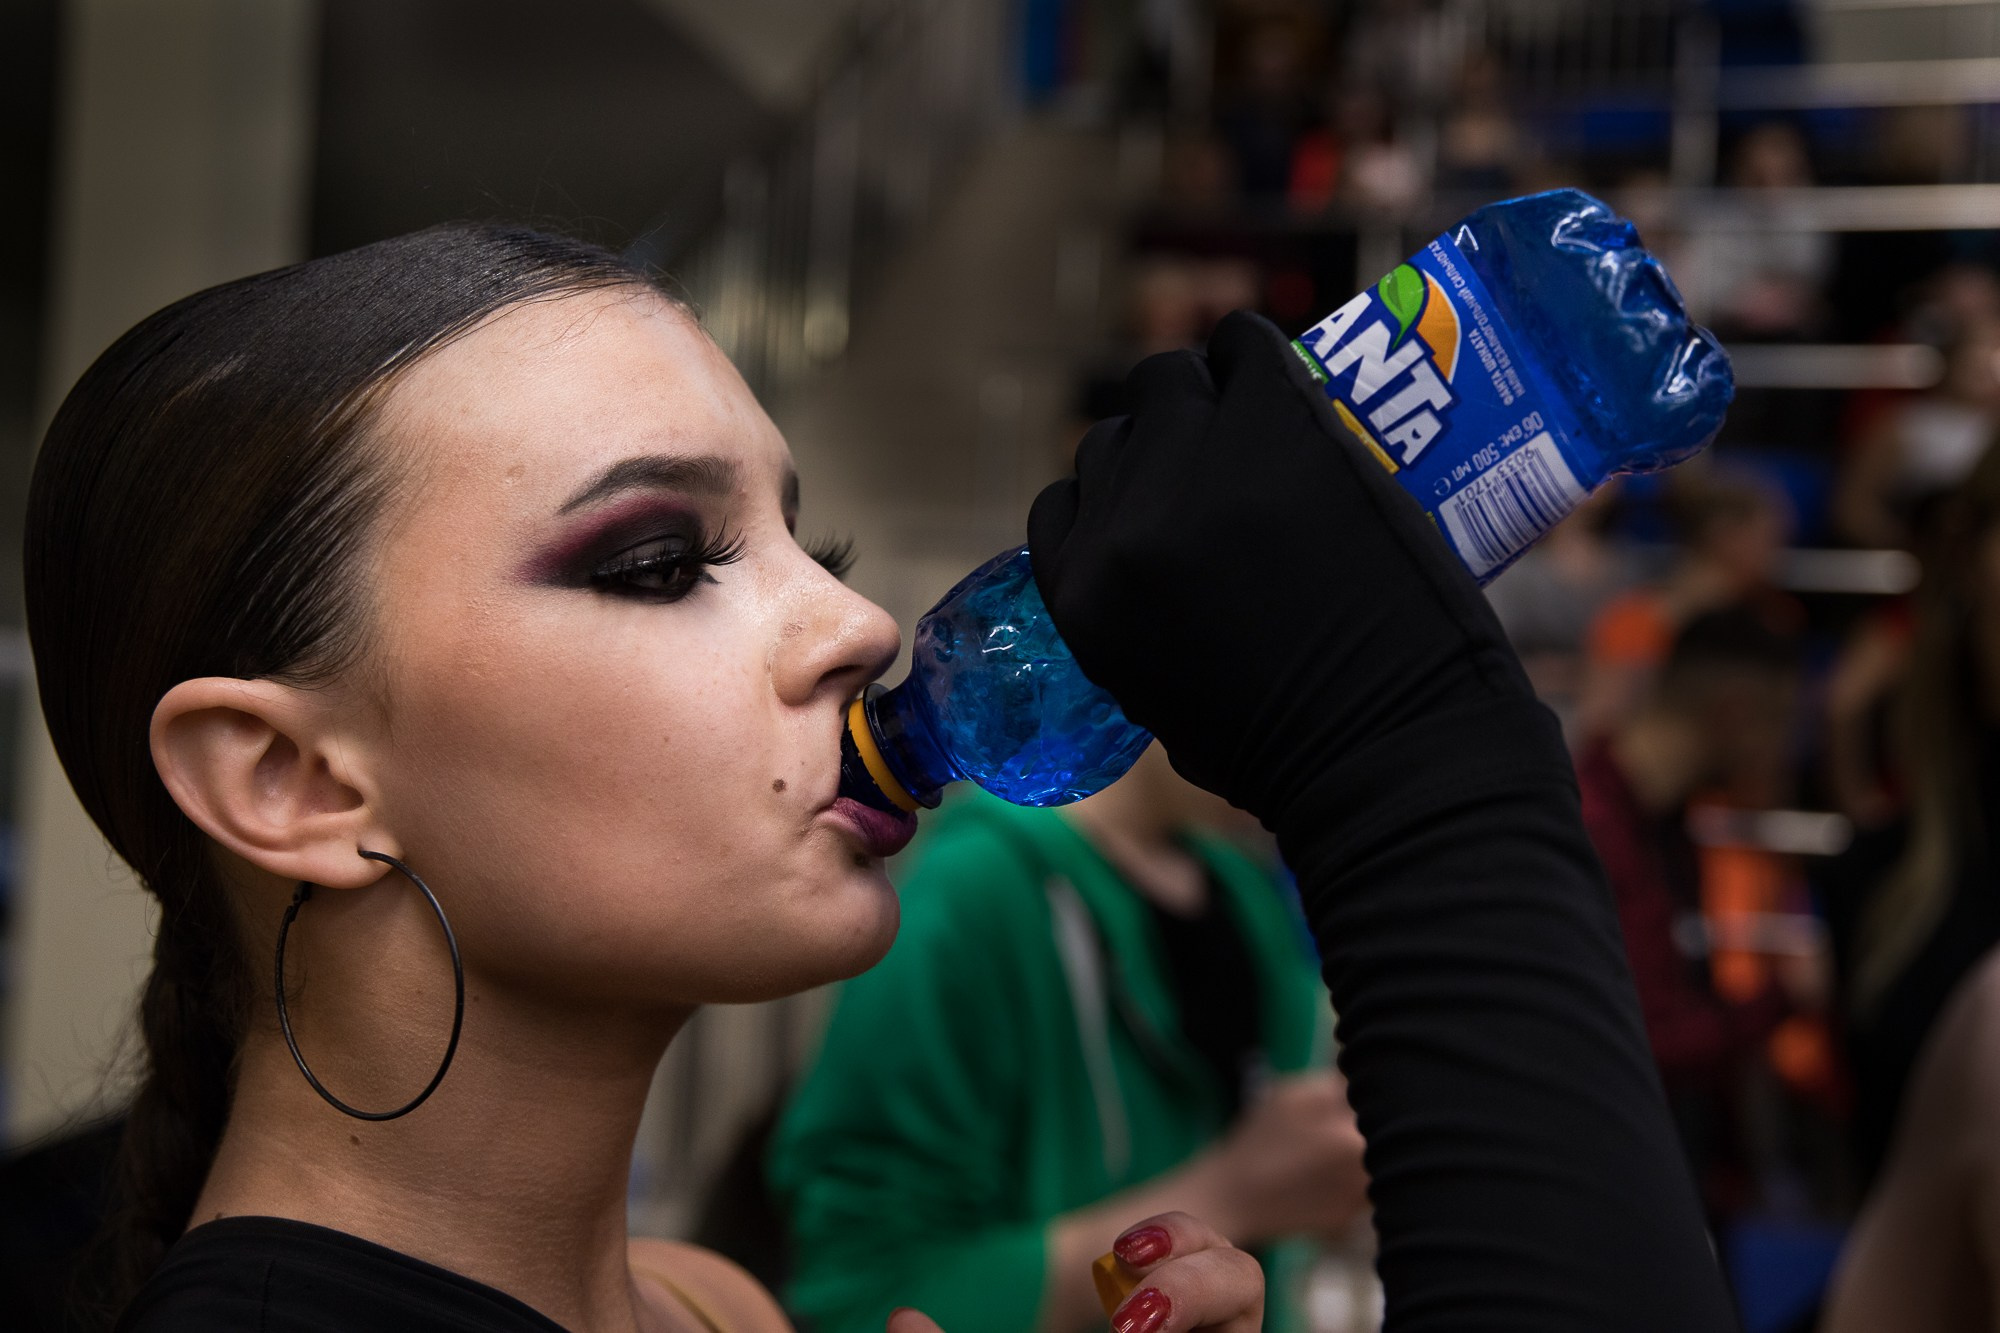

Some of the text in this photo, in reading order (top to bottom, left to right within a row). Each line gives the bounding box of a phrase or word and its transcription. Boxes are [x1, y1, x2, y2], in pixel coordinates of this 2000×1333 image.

[1468, 328, 1497, 373] ШОКАТА
[1457, 445, 1535, 505] 9033 1701
[1472, 442, 1500, 471] 500
